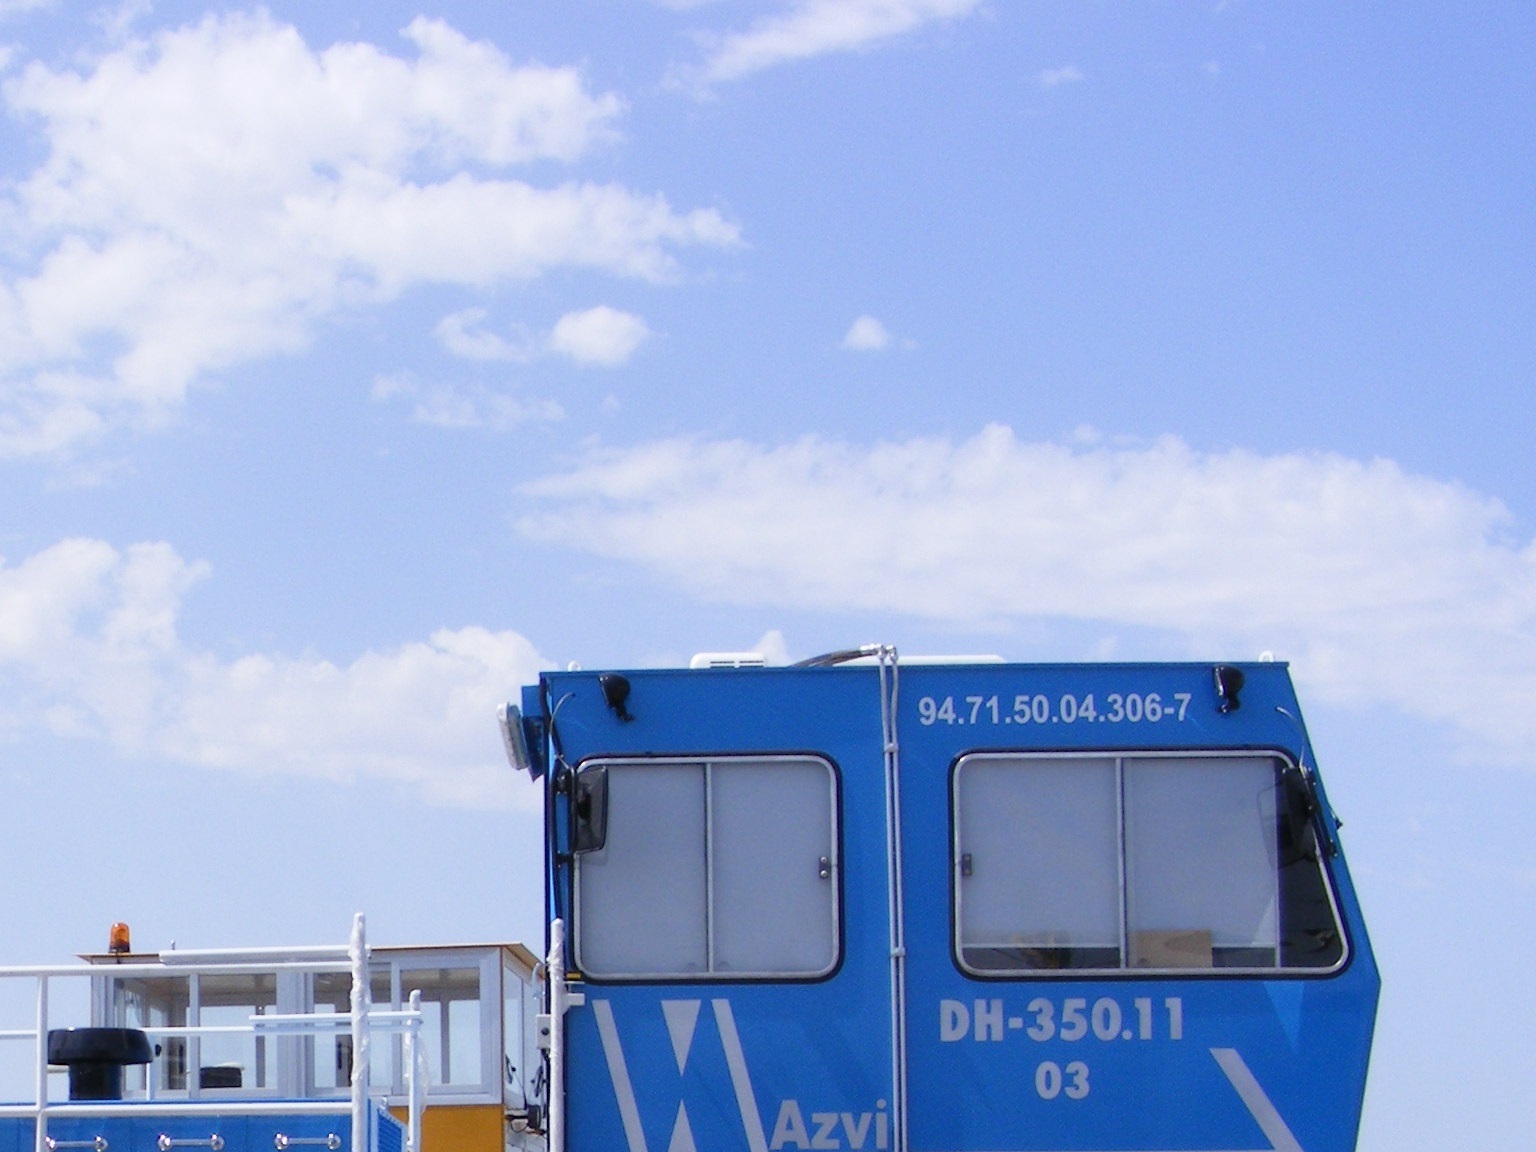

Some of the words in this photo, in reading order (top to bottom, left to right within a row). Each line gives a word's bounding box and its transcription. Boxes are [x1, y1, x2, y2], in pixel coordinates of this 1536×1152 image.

[918, 693, 1192, 725] 94.71.50.04.306-7
[939, 997, 1183, 1042] DH-350.11
[1035, 1060, 1090, 1100] 03
[769, 1098, 888, 1150] Azvi
